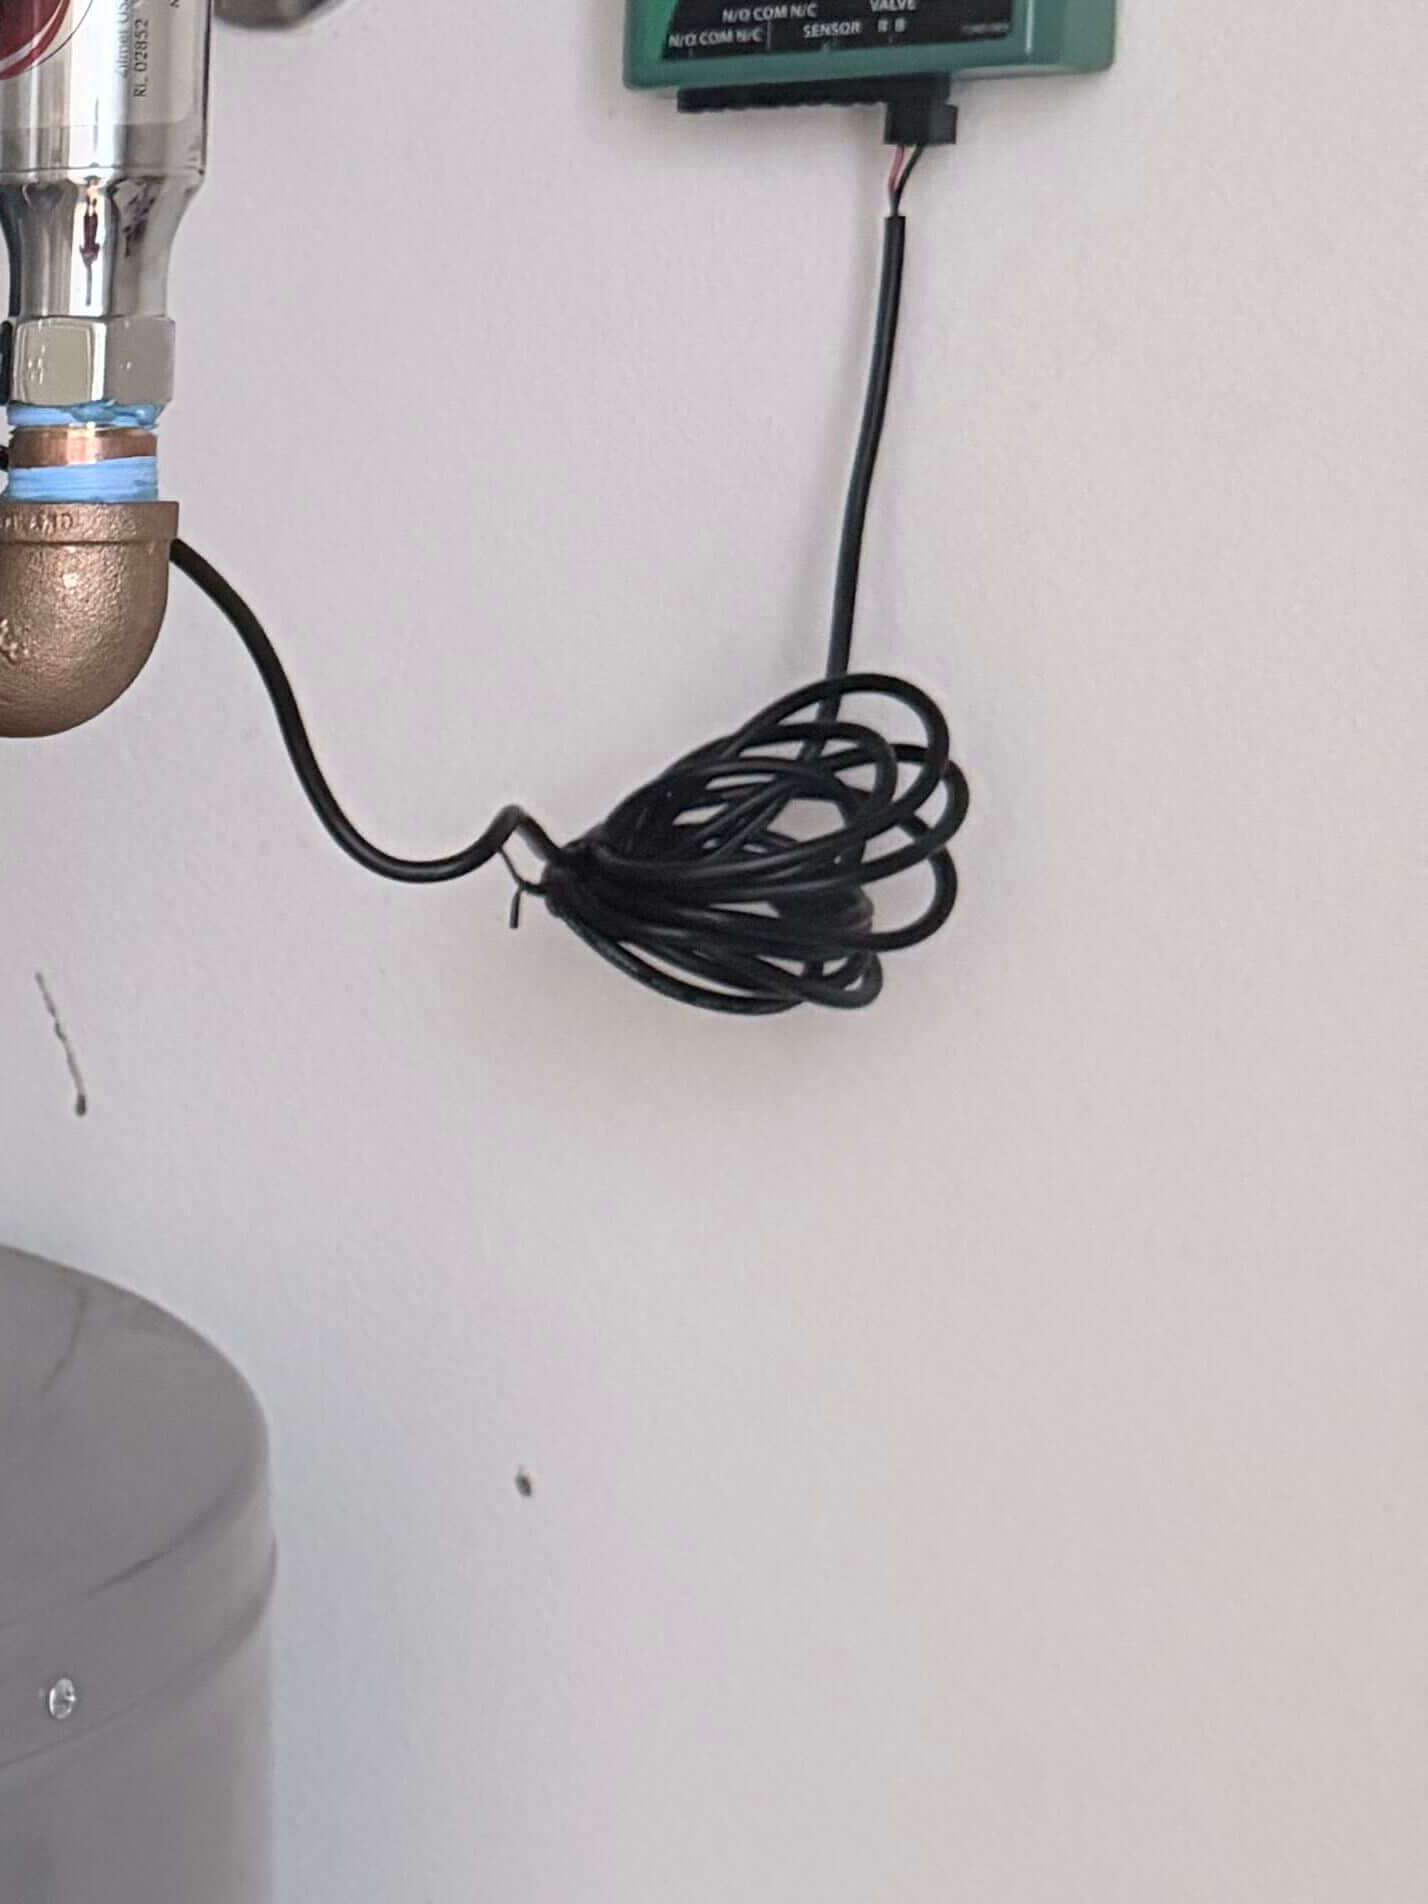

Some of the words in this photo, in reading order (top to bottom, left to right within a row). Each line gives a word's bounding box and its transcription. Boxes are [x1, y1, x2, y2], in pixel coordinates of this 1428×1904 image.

[722, 7, 750, 23] N/O
[752, 4, 789, 20] COM
[790, 2, 819, 18] N/C
[698, 29, 734, 45] COM
[802, 20, 861, 39] SENSOR
[134, 18, 150, 73] 02852
